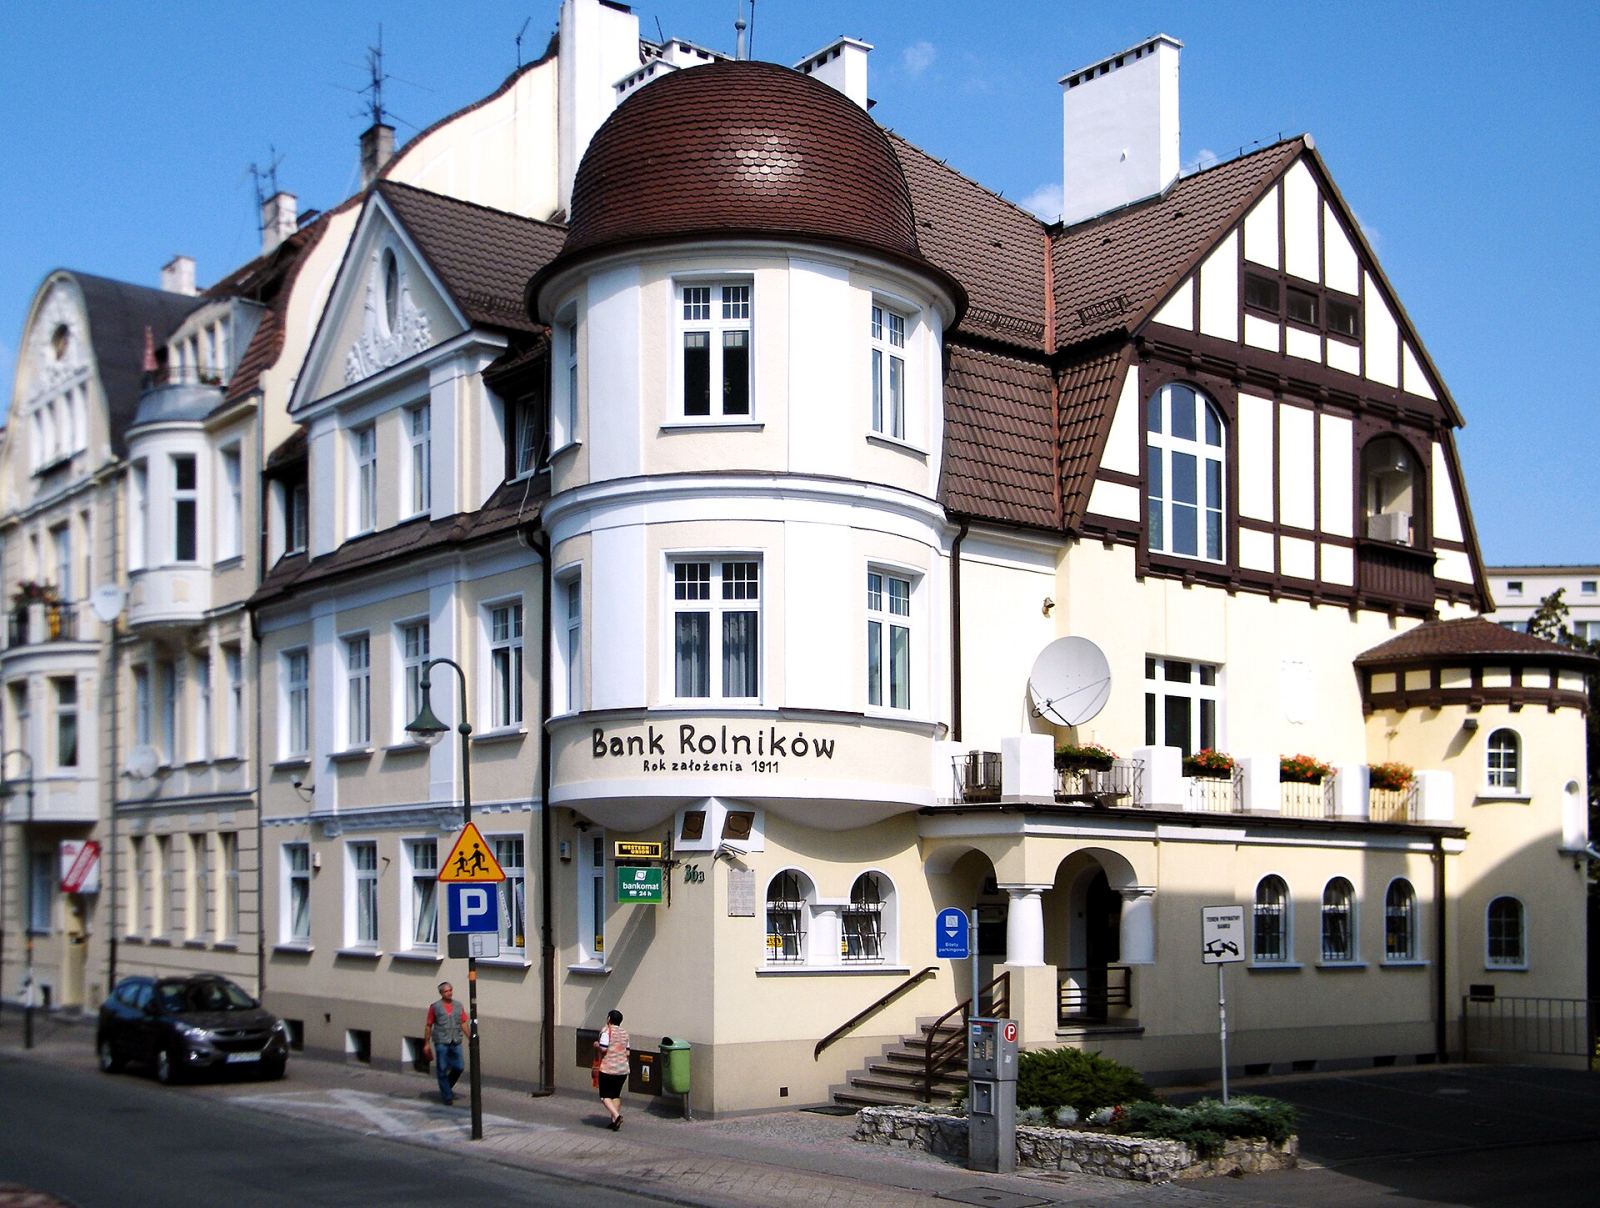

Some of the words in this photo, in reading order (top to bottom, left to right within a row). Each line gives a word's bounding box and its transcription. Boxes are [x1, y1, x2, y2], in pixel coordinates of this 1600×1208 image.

[592, 725, 665, 759] Bank
[680, 724, 835, 759] Rolników
[643, 759, 666, 773] Rok
[672, 759, 743, 773] założenia
[751, 760, 779, 774] 1911
[684, 864, 705, 882] 36a
[622, 882, 659, 890] bankomat
[459, 888, 488, 927] P
[1007, 1025, 1016, 1040] P
